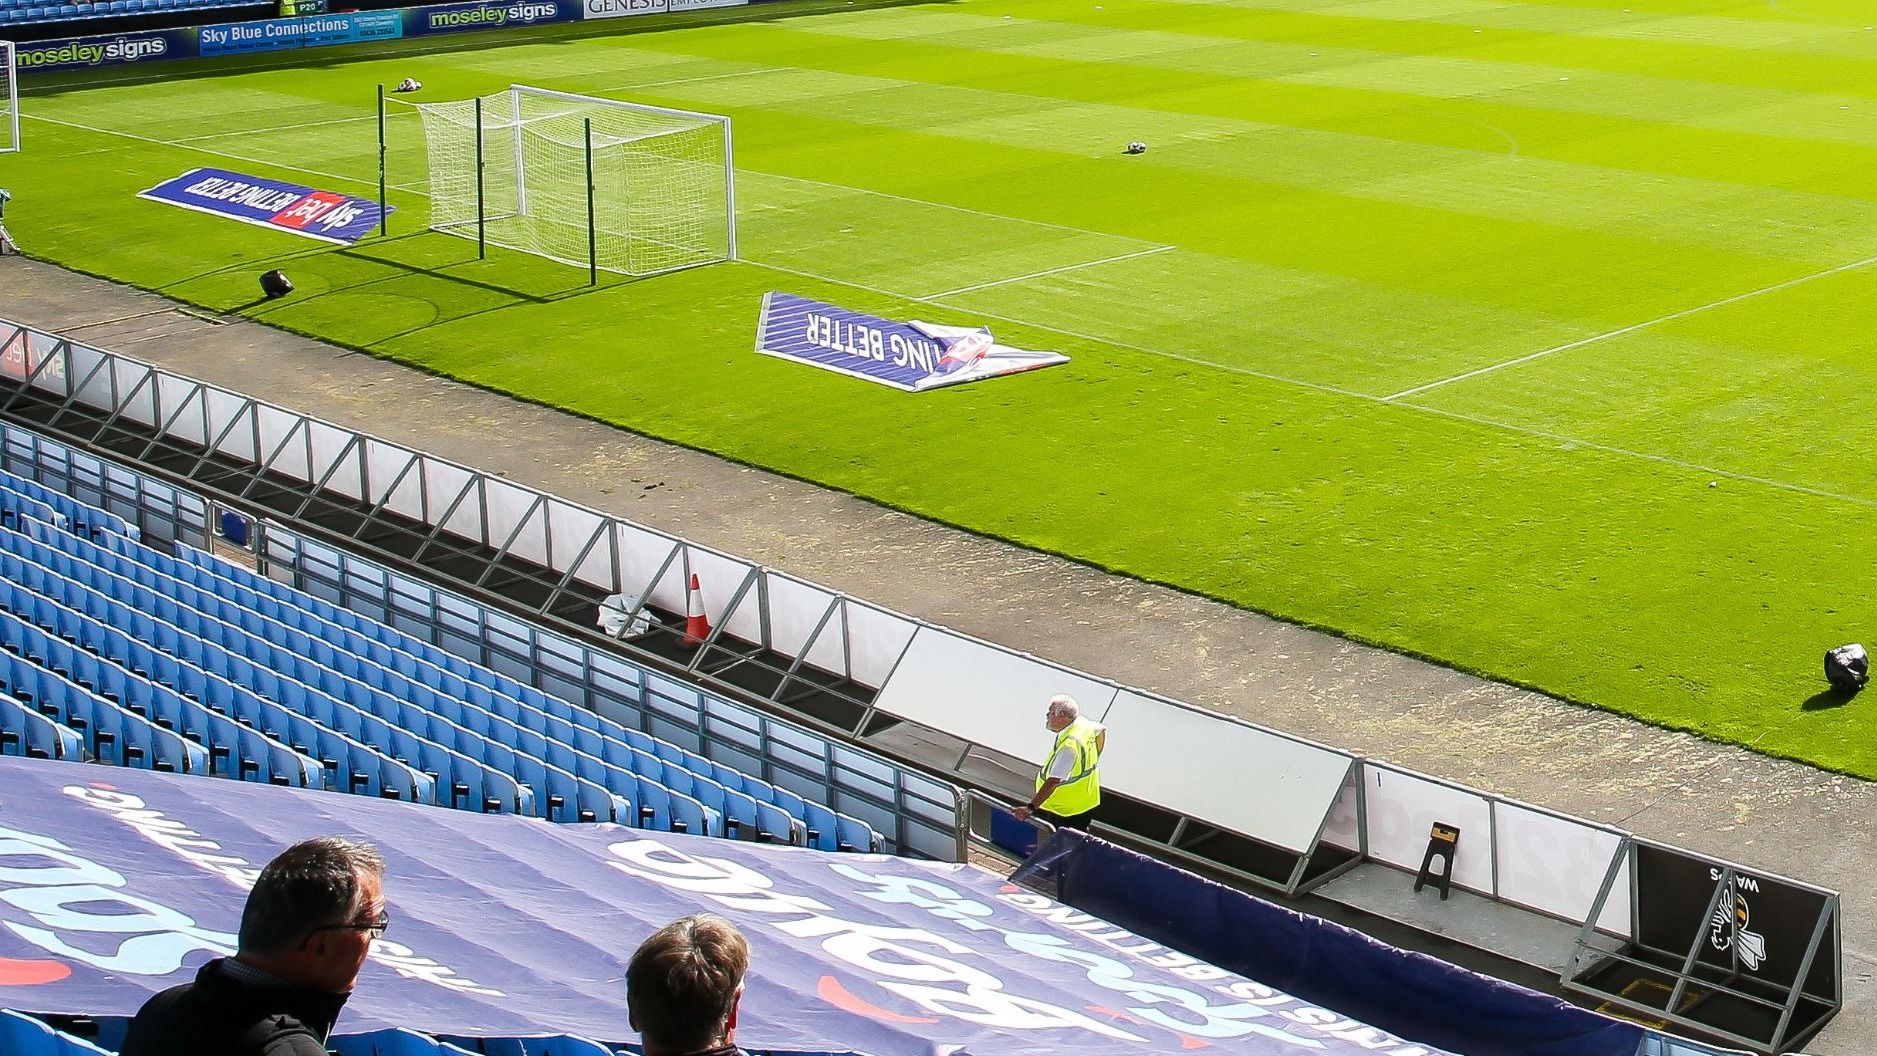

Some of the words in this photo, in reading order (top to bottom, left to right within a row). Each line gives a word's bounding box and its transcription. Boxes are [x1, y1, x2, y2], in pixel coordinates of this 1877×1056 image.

[300, 3, 316, 12] P20
[202, 29, 228, 44] Sky
[232, 25, 262, 40] Blue
[266, 18, 349, 37] Connections
[184, 175, 245, 200] BETTER
[236, 185, 301, 214] BETTING
[287, 198, 330, 230] bet
[322, 200, 365, 233] sky
[806, 312, 885, 362] BETTER
[1709, 867, 1760, 893] WAS
[1214, 980, 1293, 1009] IS
